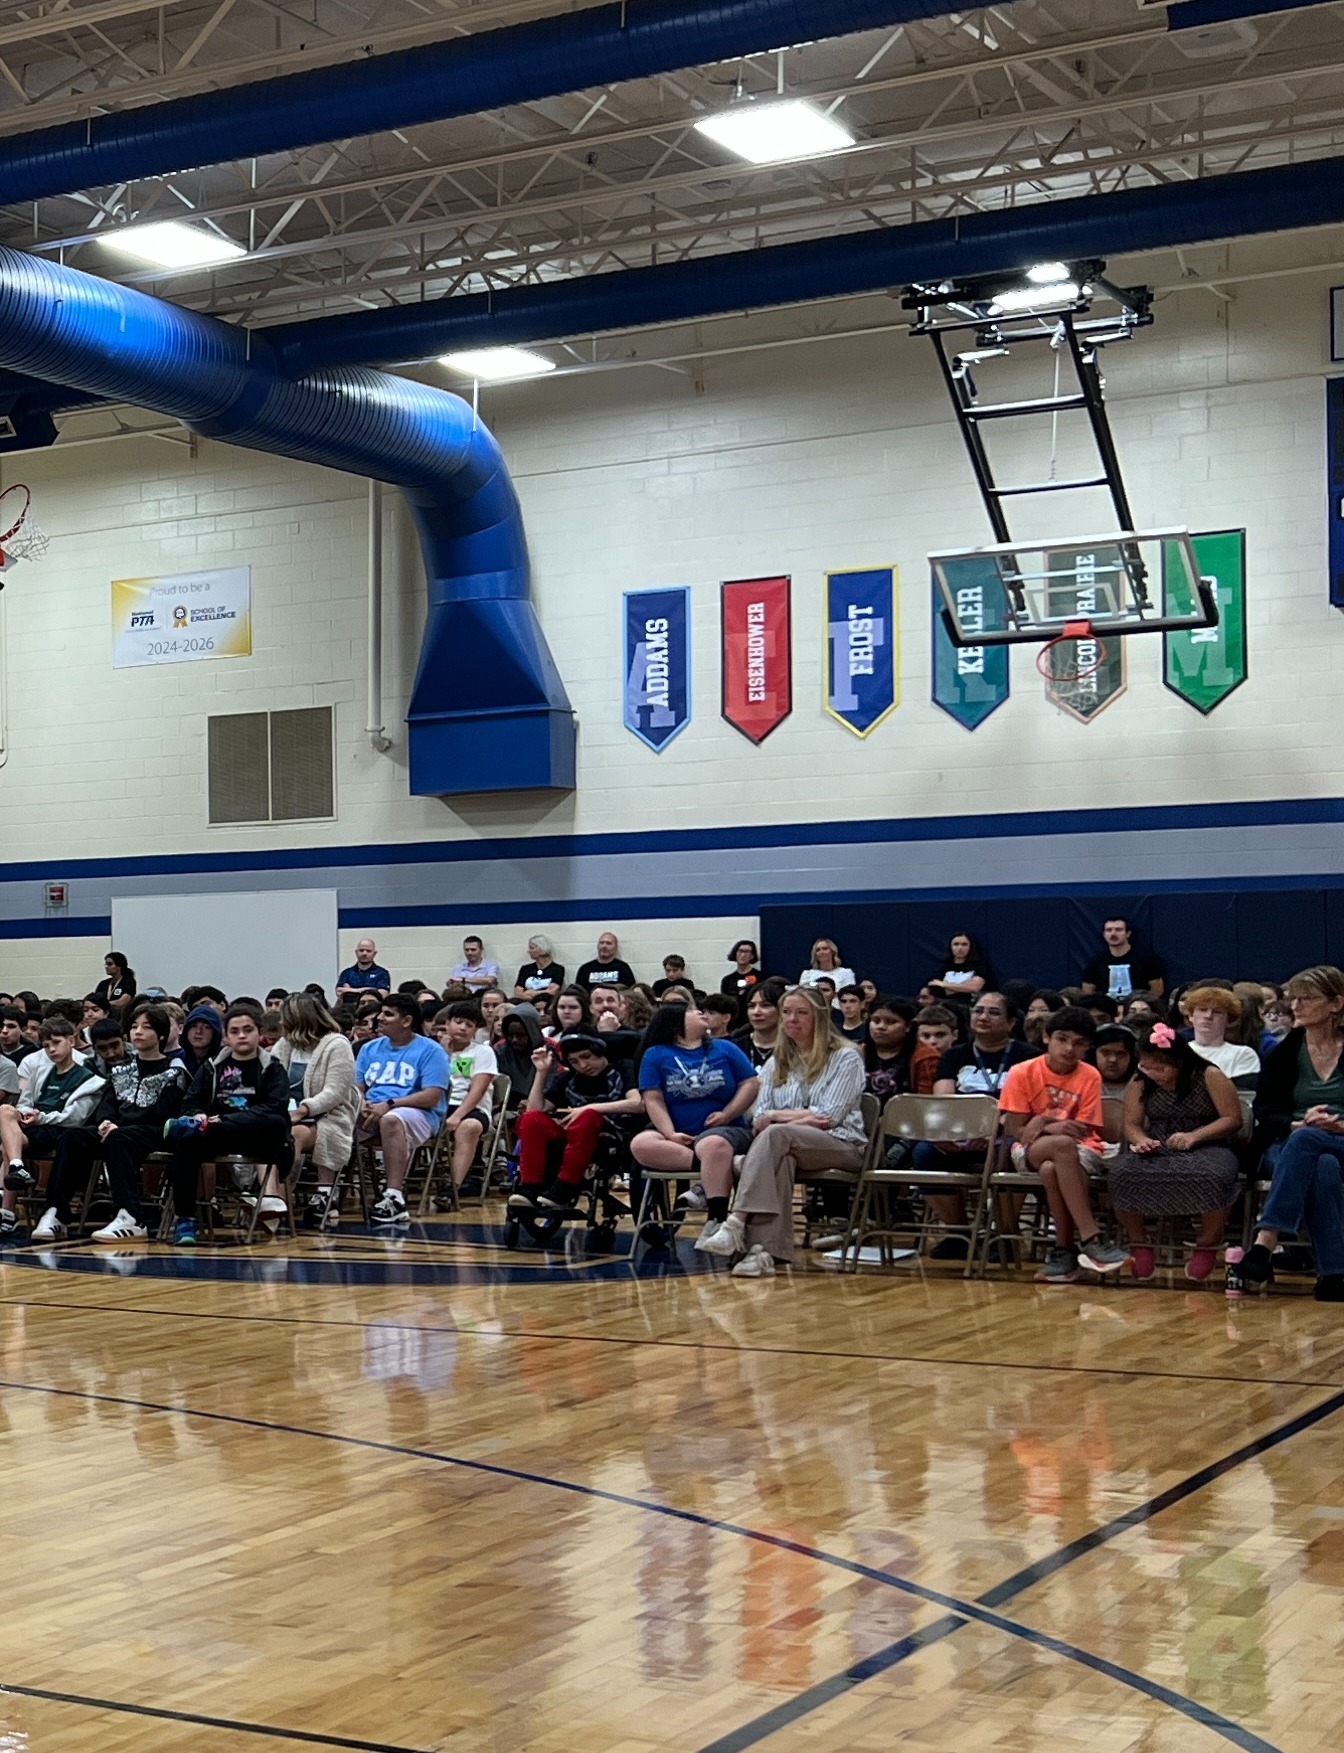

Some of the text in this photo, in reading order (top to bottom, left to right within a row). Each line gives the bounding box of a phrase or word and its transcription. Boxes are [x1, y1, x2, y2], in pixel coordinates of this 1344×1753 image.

[150, 584, 176, 596] Proud
[178, 584, 188, 594] to
[190, 583, 203, 592] be
[131, 615, 154, 627] PTA
[190, 607, 216, 616] SCHOOL
[190, 611, 236, 622] EXCELLENCE
[848, 604, 874, 676] FROST
[957, 585, 984, 676] KELER
[147, 637, 214, 655] 2024-2026
[747, 602, 766, 702] EISENHOWER
[645, 617, 670, 708] ADDAMS
[363, 1061, 415, 1087] GAP
